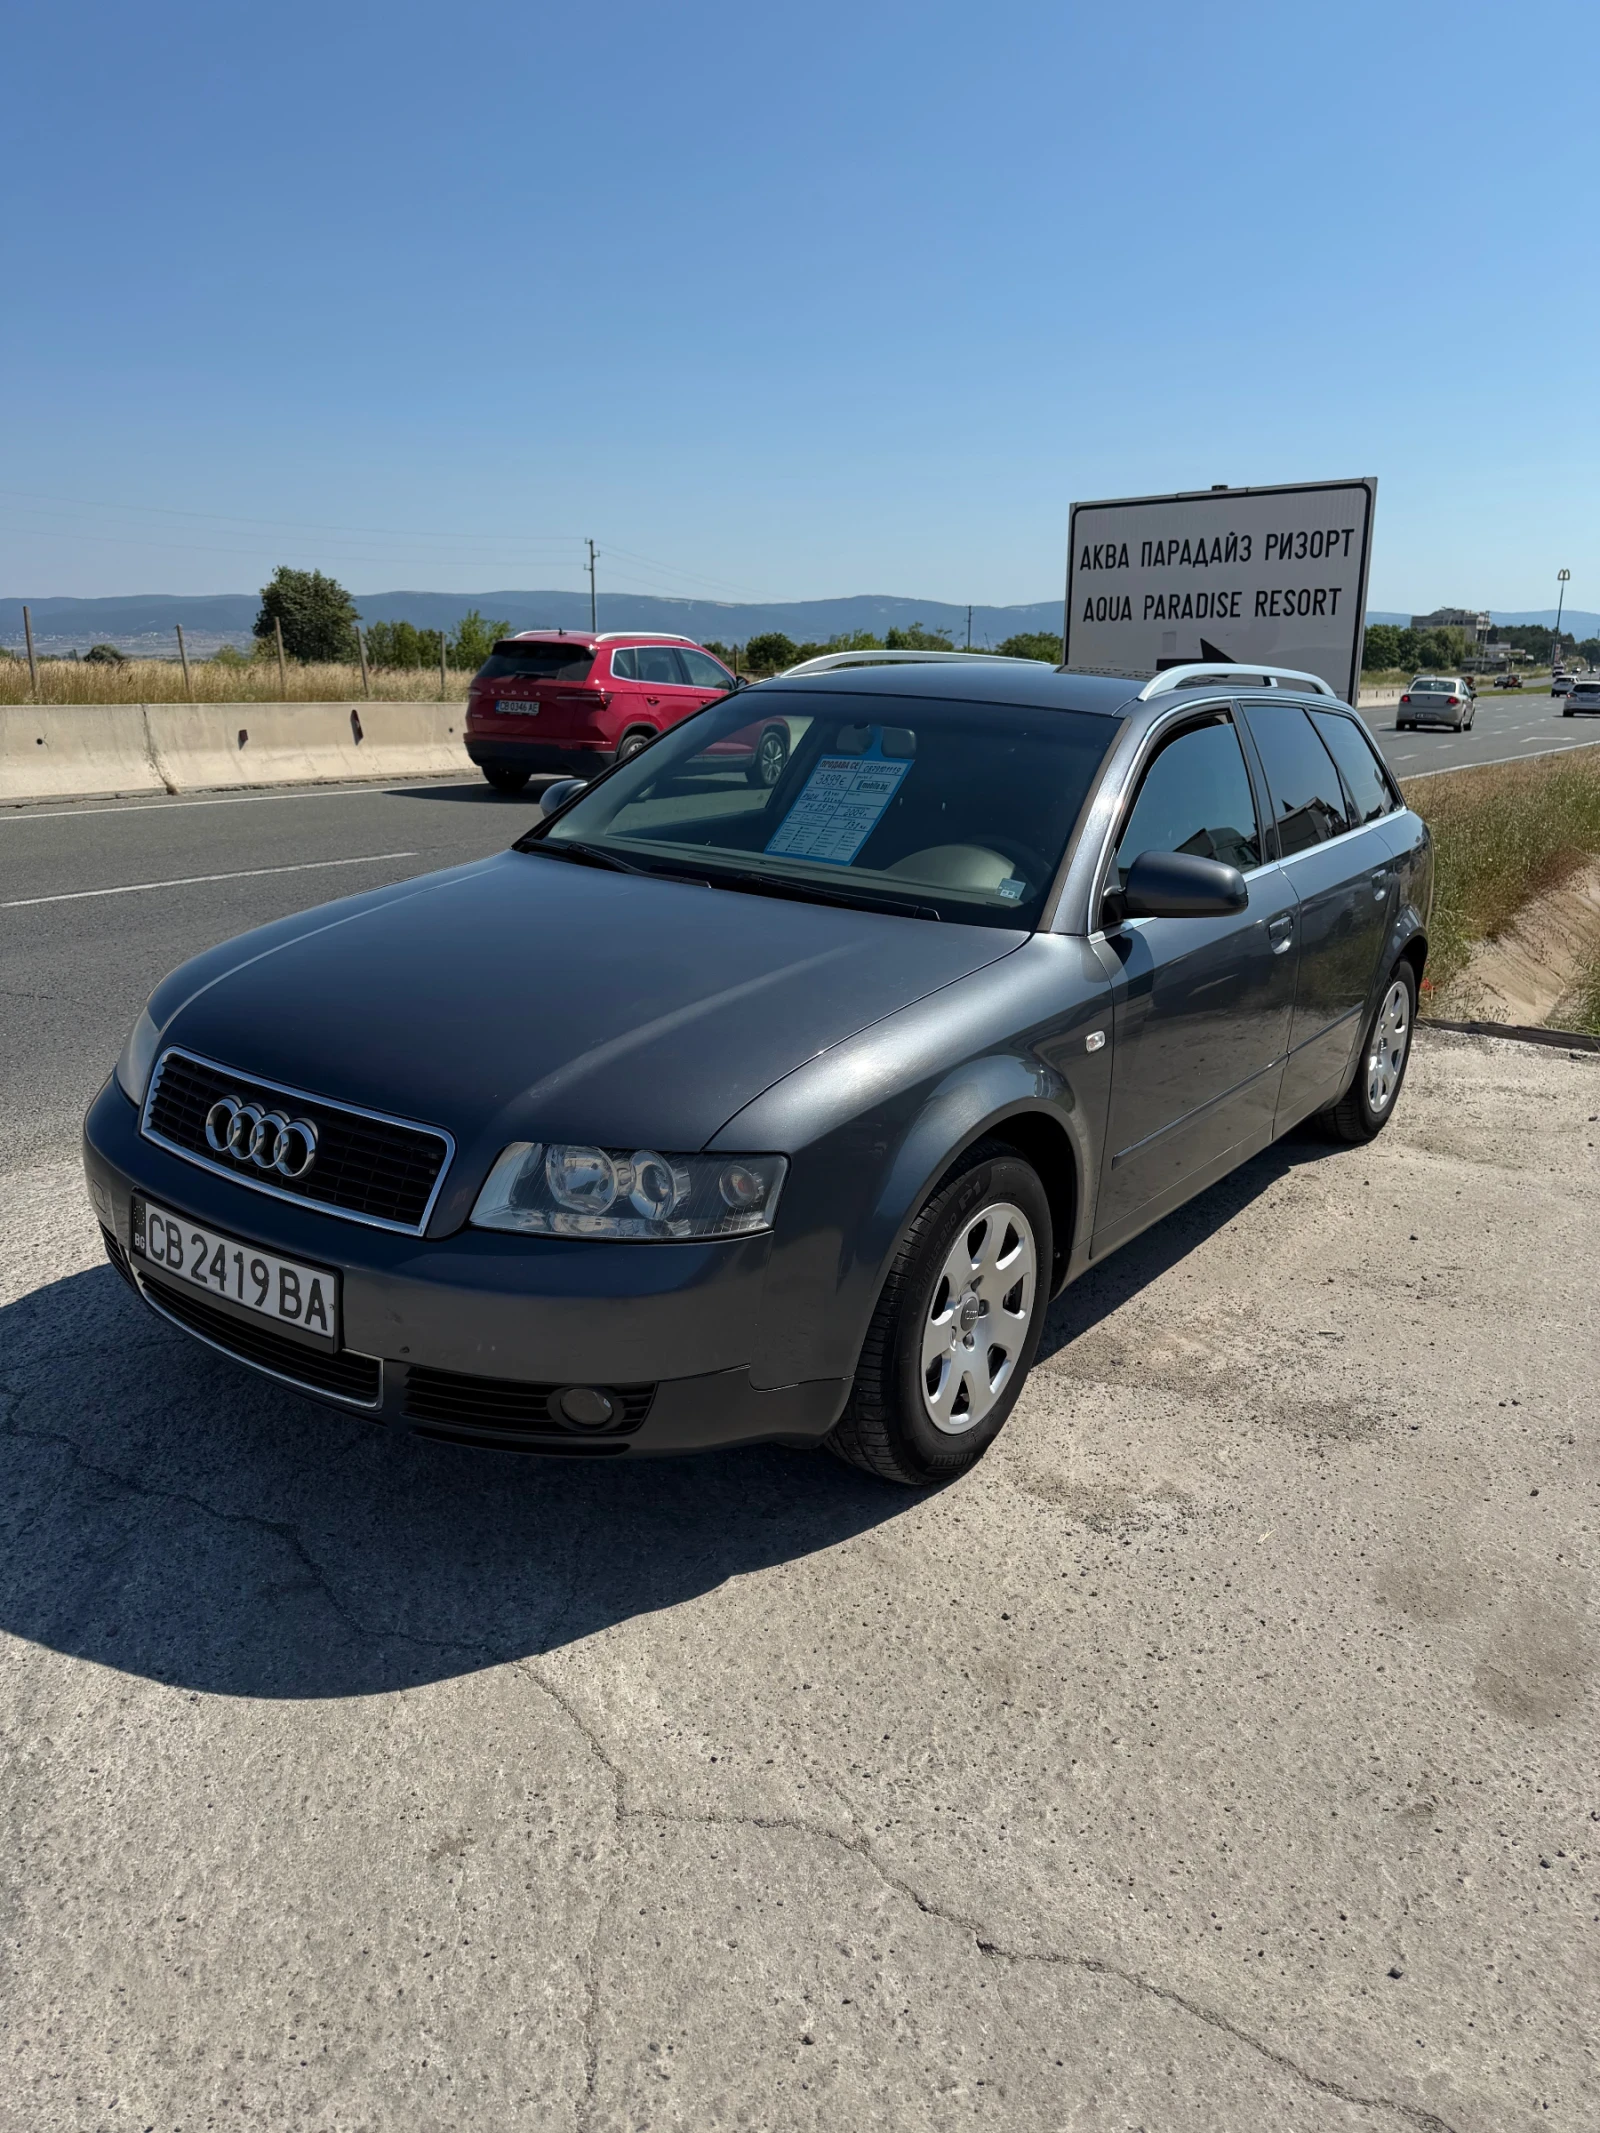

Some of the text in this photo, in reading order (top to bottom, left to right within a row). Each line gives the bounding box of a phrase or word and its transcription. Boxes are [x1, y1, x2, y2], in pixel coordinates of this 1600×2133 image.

[1079, 528, 1355, 571] АКВА ПАРАДАЙЗ РИЗОРТ
[1082, 588, 1342, 622] AQUA PARADISE RESORT
[134, 1232, 146, 1250] BG
